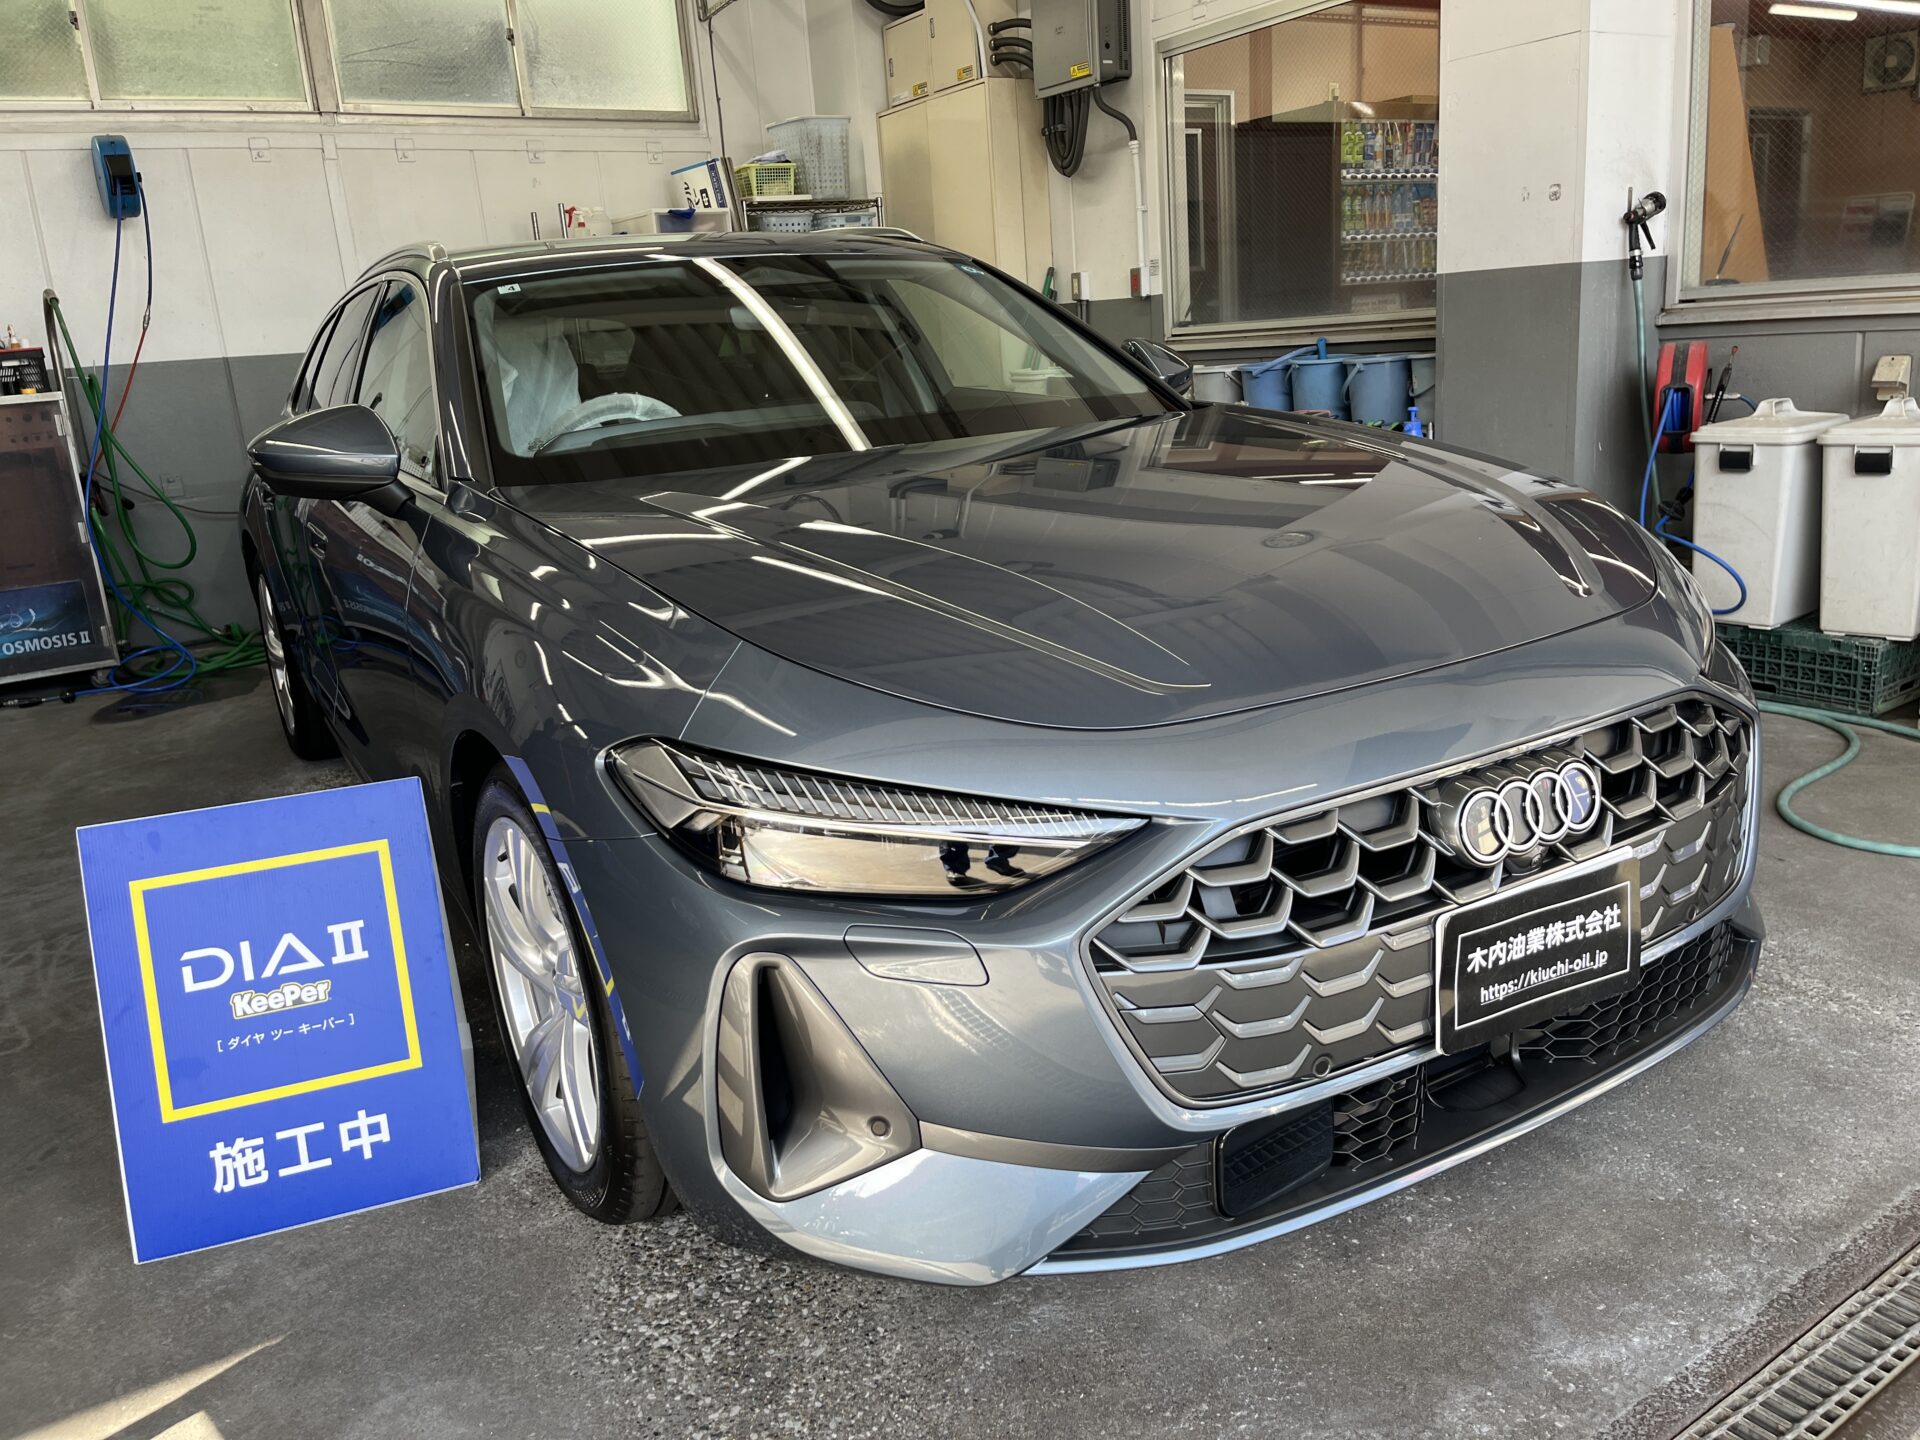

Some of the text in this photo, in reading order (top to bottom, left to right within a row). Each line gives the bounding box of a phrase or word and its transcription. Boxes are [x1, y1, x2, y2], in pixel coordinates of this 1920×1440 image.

[2, 632, 78, 656] OSMOSIS
[180, 932, 325, 993] DIA
[1466, 903, 1622, 974] 木内油業株式会社
[231, 980, 331, 1019] KeePer
[1480, 949, 1608, 1004] https://kiuchi-oil.jp
[209, 1109, 391, 1194] 施工中
